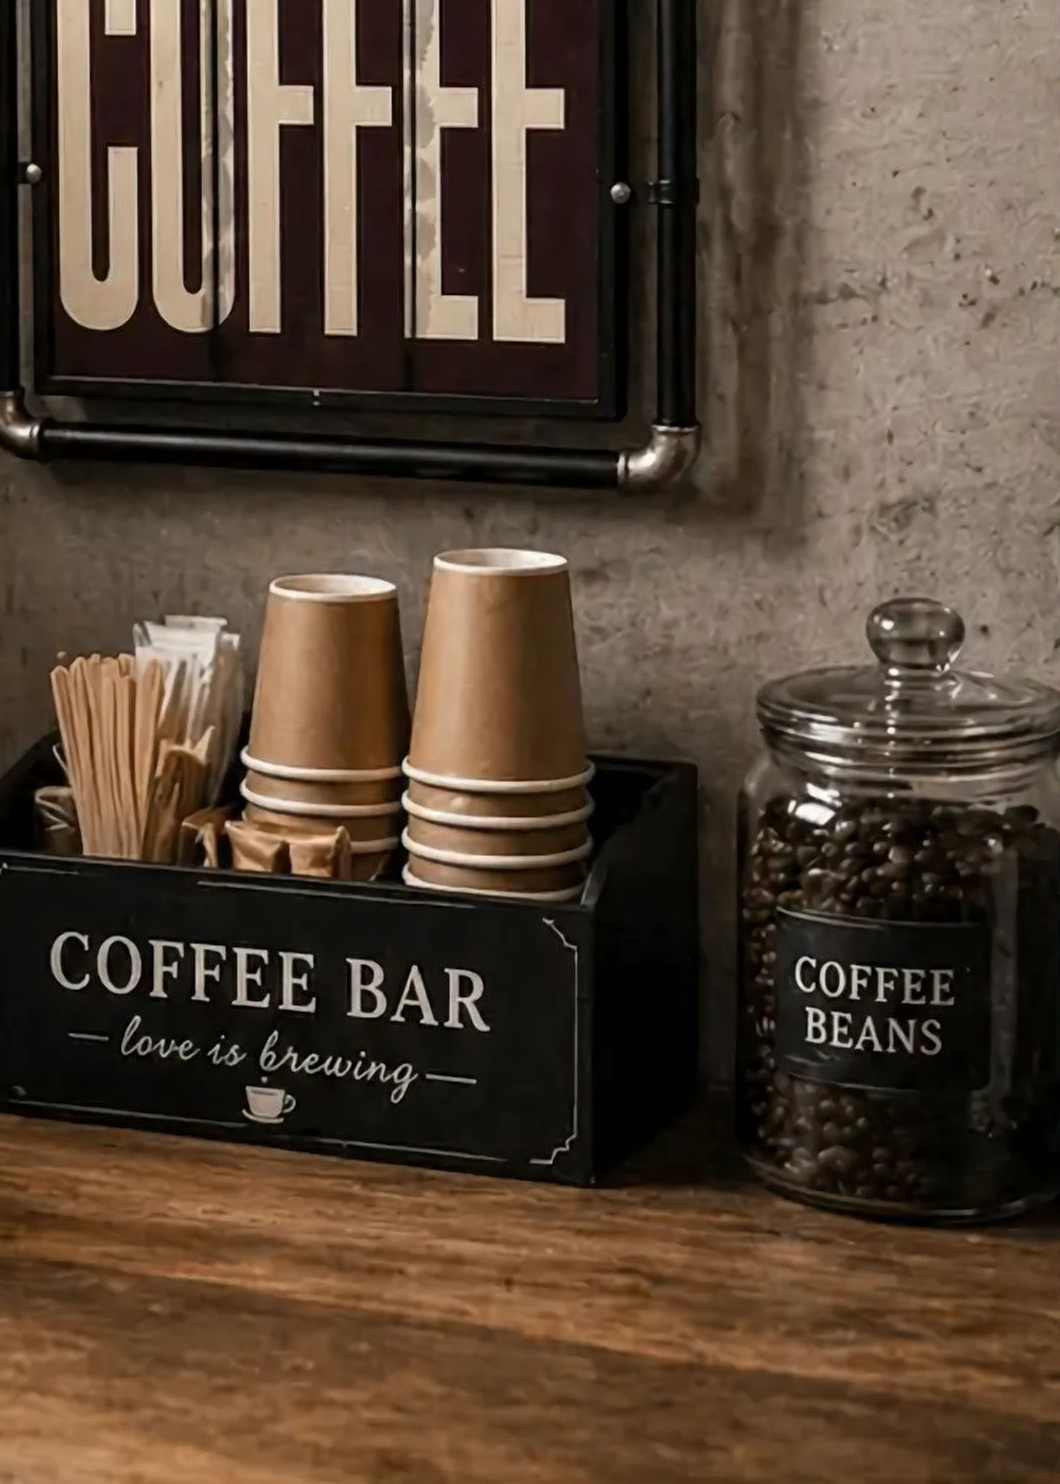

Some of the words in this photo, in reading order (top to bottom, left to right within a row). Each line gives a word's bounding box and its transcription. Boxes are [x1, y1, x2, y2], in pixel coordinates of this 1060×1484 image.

[50, 931, 317, 1014] COFFEE
[345, 957, 491, 1032] BAR
[794, 955, 955, 1006] COFFEE
[120, 1014, 200, 1061] love
[207, 1034, 247, 1067] is
[259, 1030, 418, 1103] brewing
[804, 1006, 942, 1056] BEANS
